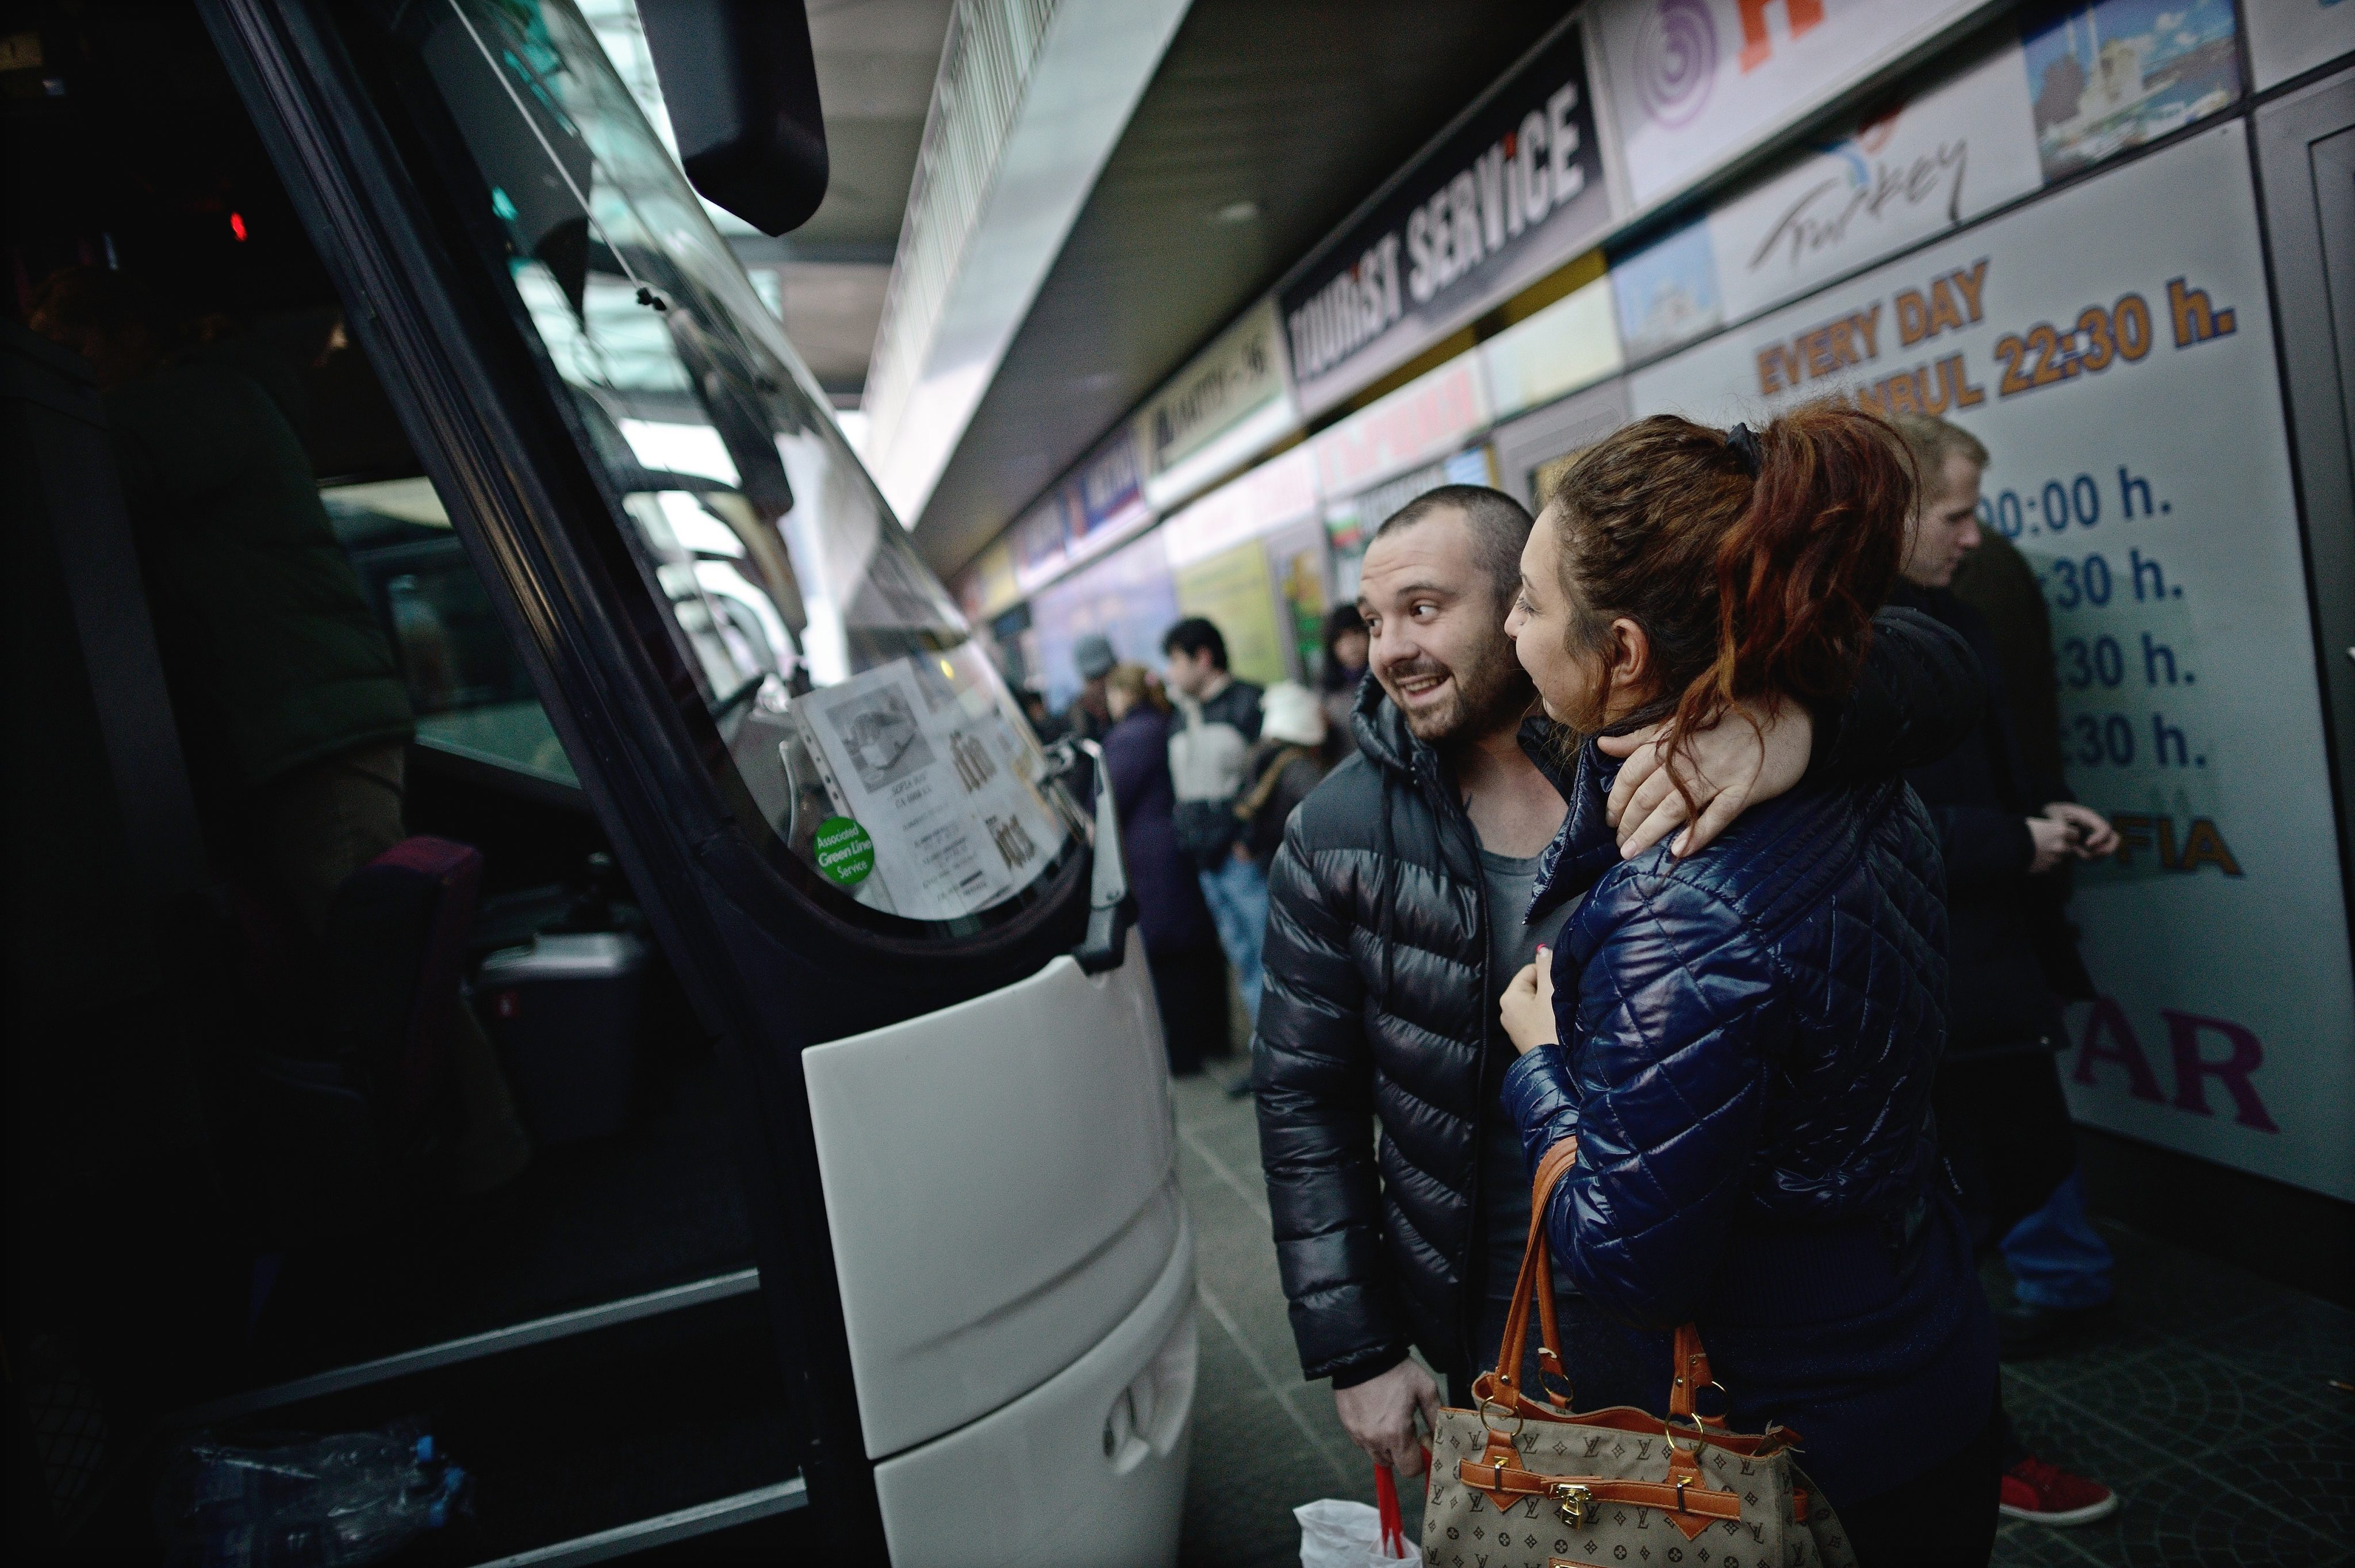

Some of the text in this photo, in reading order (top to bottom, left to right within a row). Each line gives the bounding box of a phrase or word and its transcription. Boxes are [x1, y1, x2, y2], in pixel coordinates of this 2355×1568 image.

[1756, 257, 1991, 397] EVERY DAY
[1993, 292, 2152, 399] 22:30
[2166, 276, 2237, 349] h.
[2118, 465, 2173, 519] h.
[2130, 547, 2184, 601] h.
[2142, 631, 2196, 687] h.
[2153, 712, 2207, 767] h.
[818, 823, 860, 849] Associated
[818, 847, 852, 867] Green
[2111, 812, 2246, 877] FIA
[837, 860, 867, 879] Service
[2073, 995, 2281, 1135] AR
